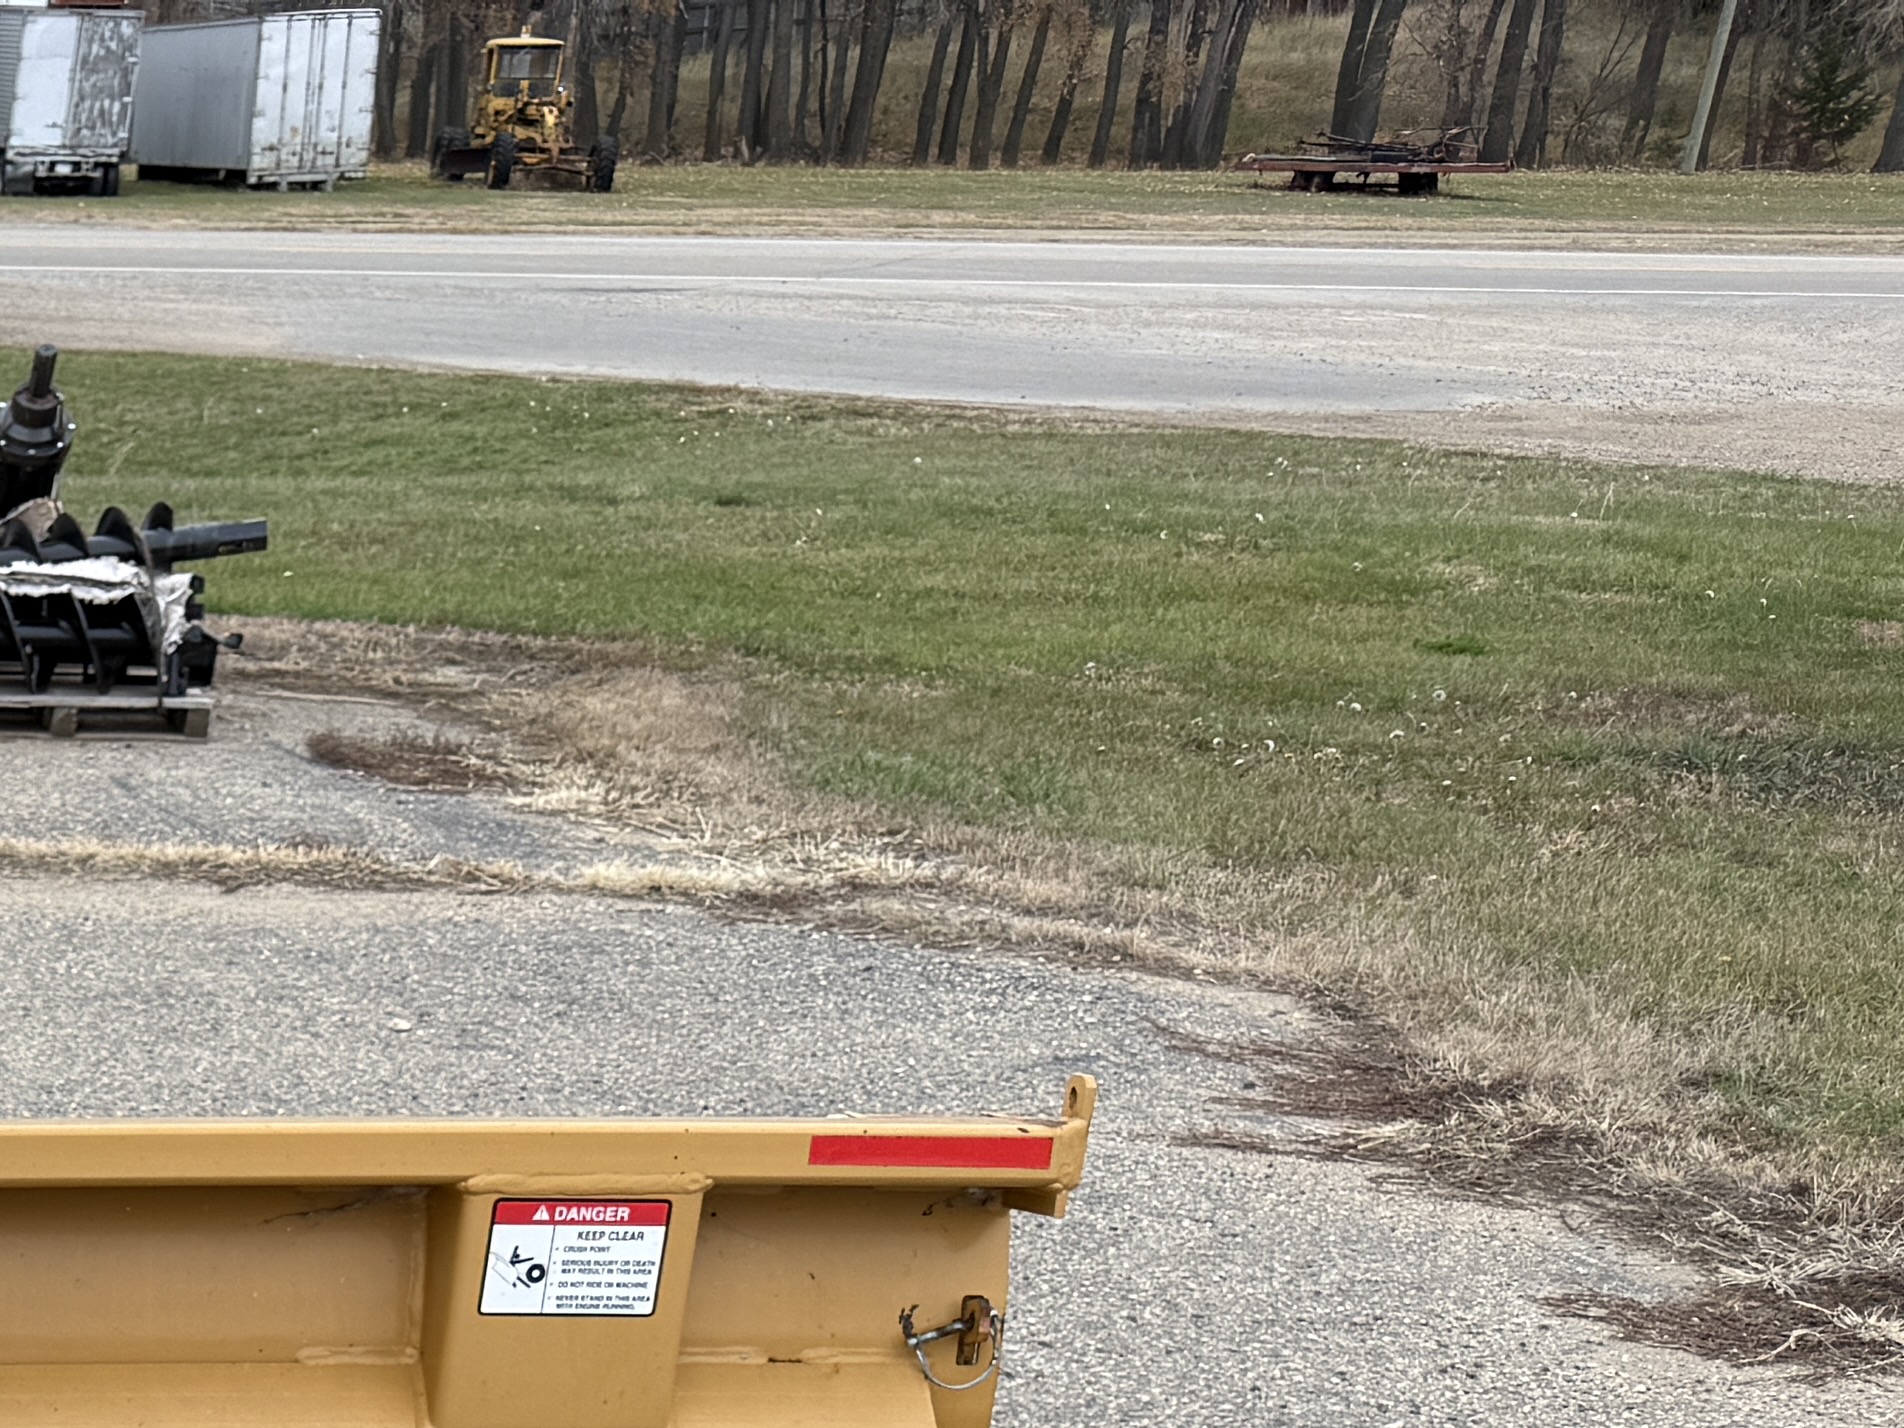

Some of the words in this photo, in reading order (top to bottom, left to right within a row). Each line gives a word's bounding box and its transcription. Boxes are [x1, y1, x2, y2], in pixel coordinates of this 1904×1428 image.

[553, 1206, 630, 1222] DANGER
[577, 1231, 606, 1241] KEEP
[608, 1231, 644, 1241] CLEAR
